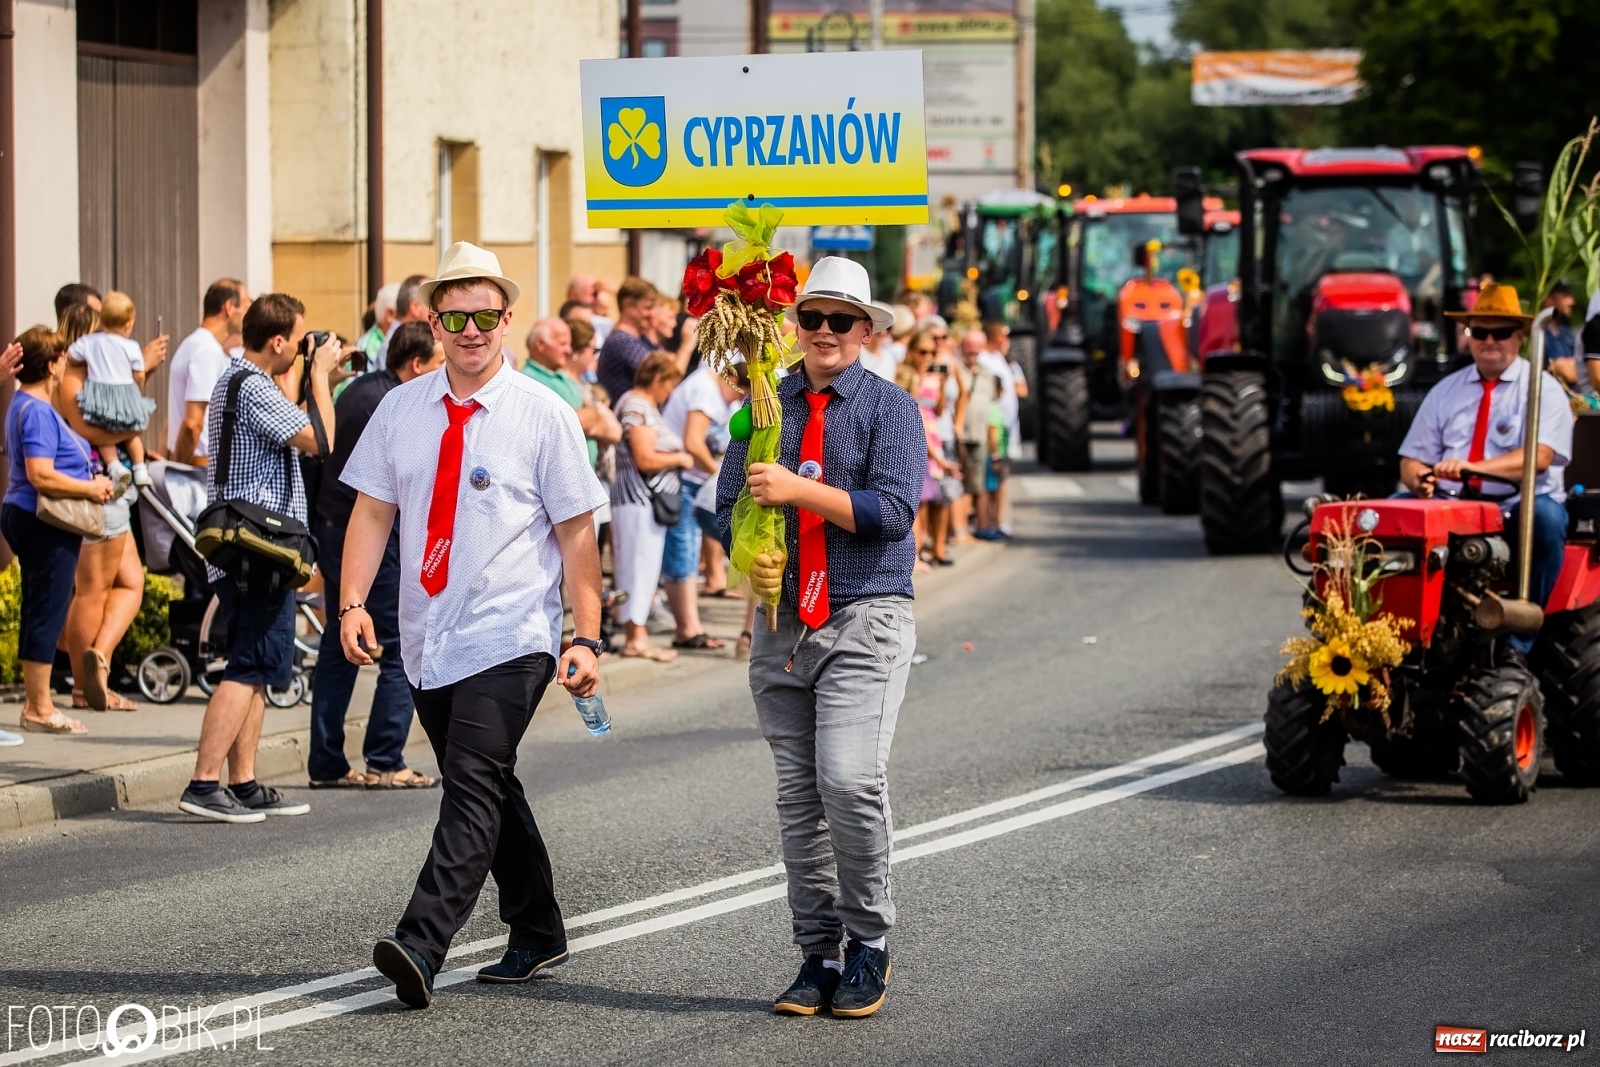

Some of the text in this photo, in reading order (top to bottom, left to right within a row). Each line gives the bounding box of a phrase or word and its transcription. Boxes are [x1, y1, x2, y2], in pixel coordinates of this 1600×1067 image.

[683, 97, 901, 167] CYPRZANÓW
[422, 538, 444, 572] SOŁECTWO
[426, 538, 451, 578] CYPRZANÓW
[800, 571, 818, 608] SOŁECTWO
[806, 570, 826, 613] CYPRZANÓW
